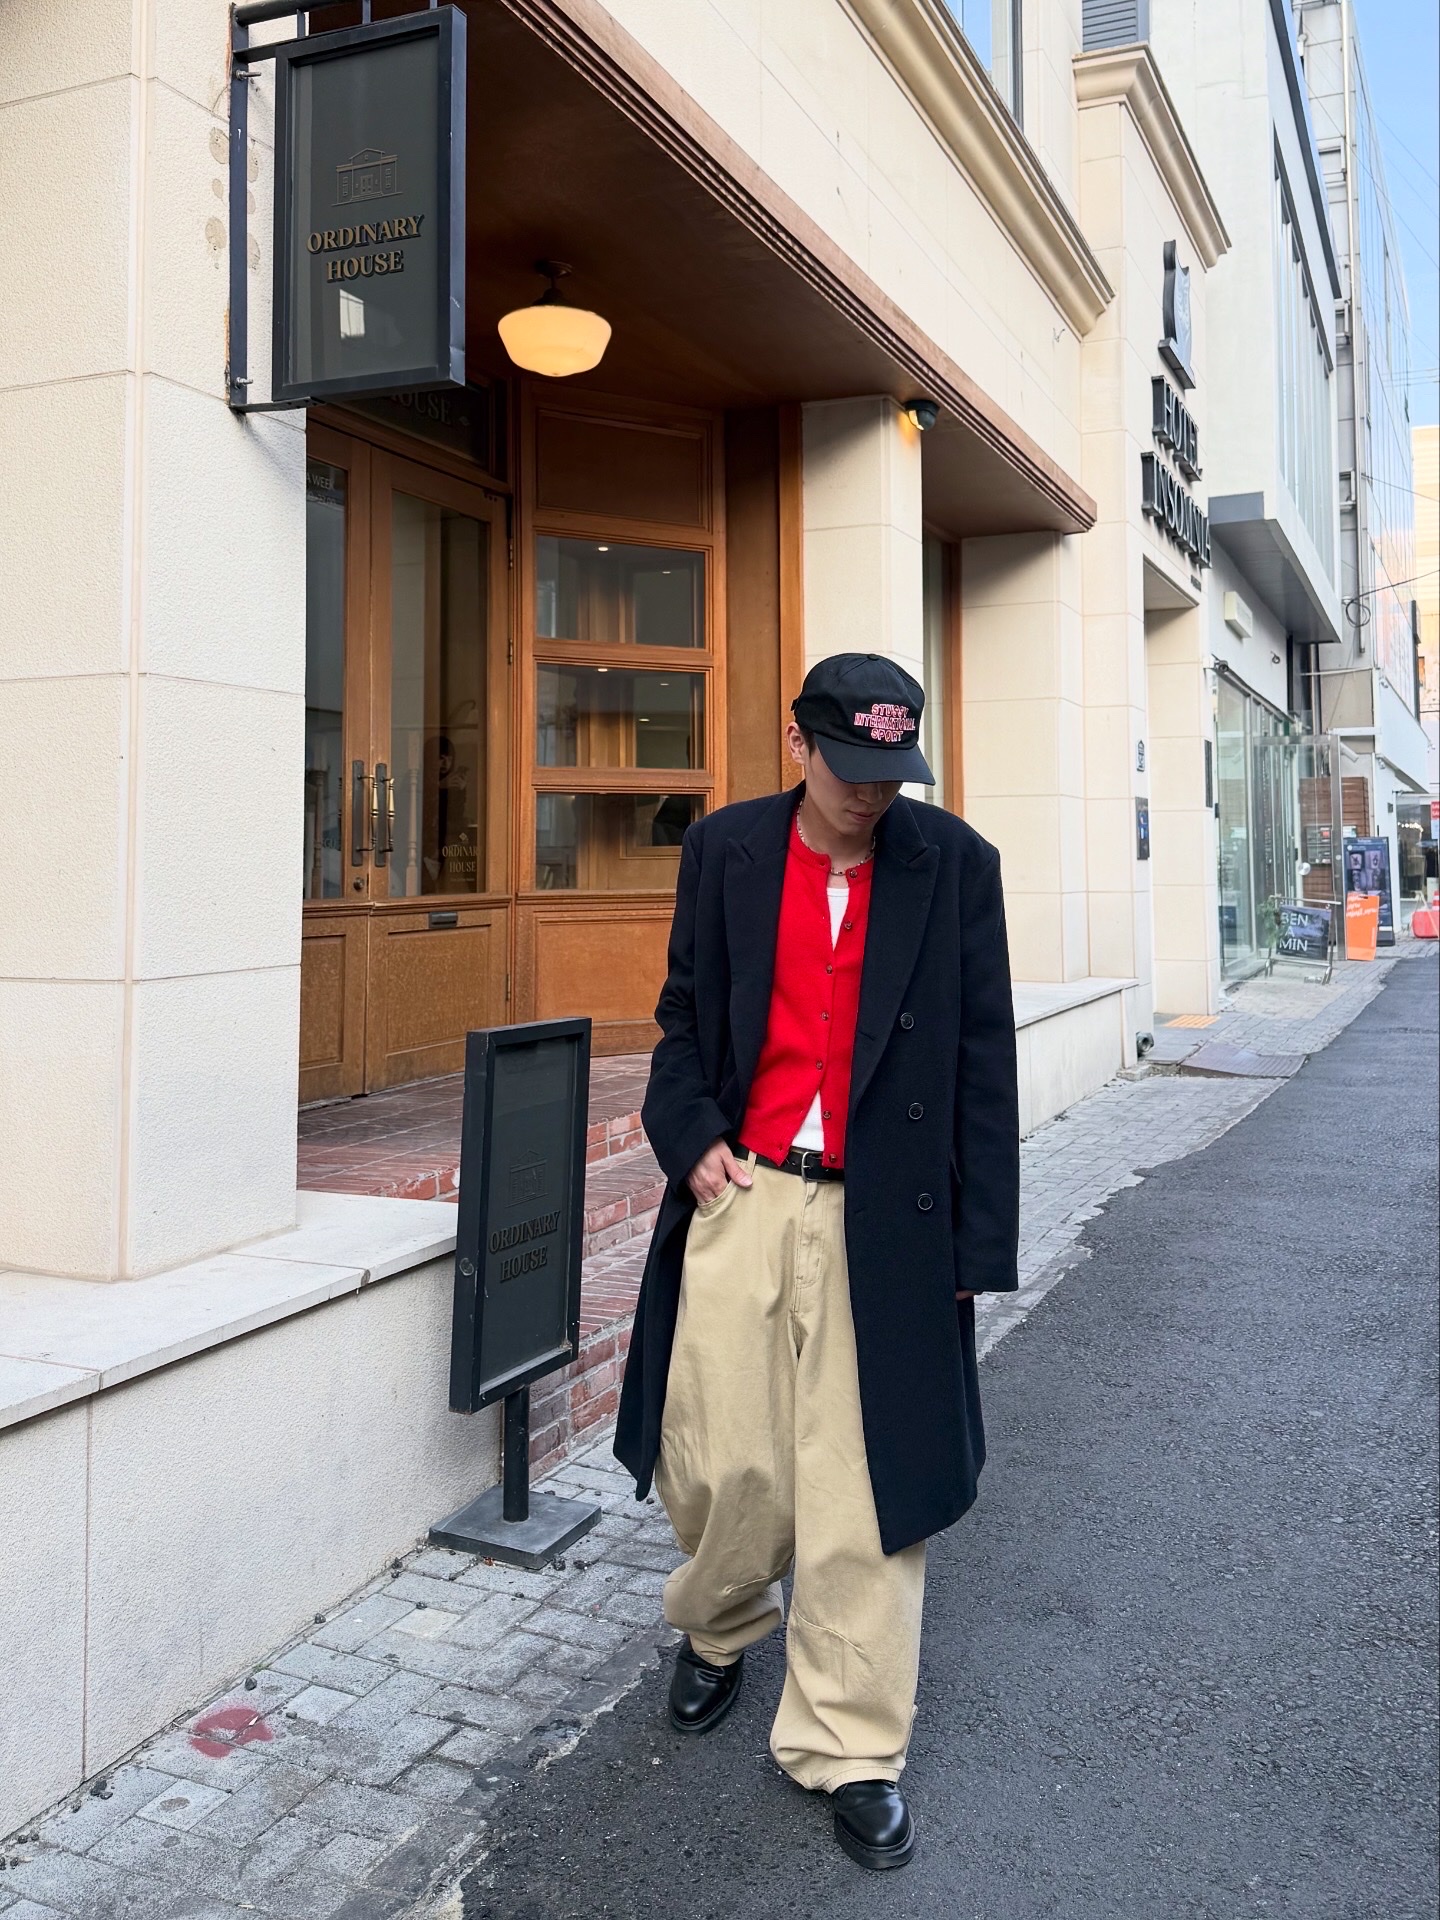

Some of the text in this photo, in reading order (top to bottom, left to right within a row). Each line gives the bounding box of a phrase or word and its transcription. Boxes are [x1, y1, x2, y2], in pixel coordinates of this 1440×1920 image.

[306, 213, 424, 254] ORDINARY
[327, 250, 403, 282] HOUSE
[392, 391, 451, 425] OUSE
[1153, 376, 1203, 481] HOTEL
[1144, 452, 1212, 569] INSOMNIA
[853, 712, 916, 731] INTERNATIONAL
[870, 728, 904, 742] SPORT
[441, 845, 482, 857] ORDINAR
[449, 861, 476, 873] HOUSE
[1280, 912, 1309, 927] BEN
[1279, 938, 1309, 952] MIN
[489, 1210, 561, 1254] ORDINARY
[500, 1246, 549, 1283] HOUSE
